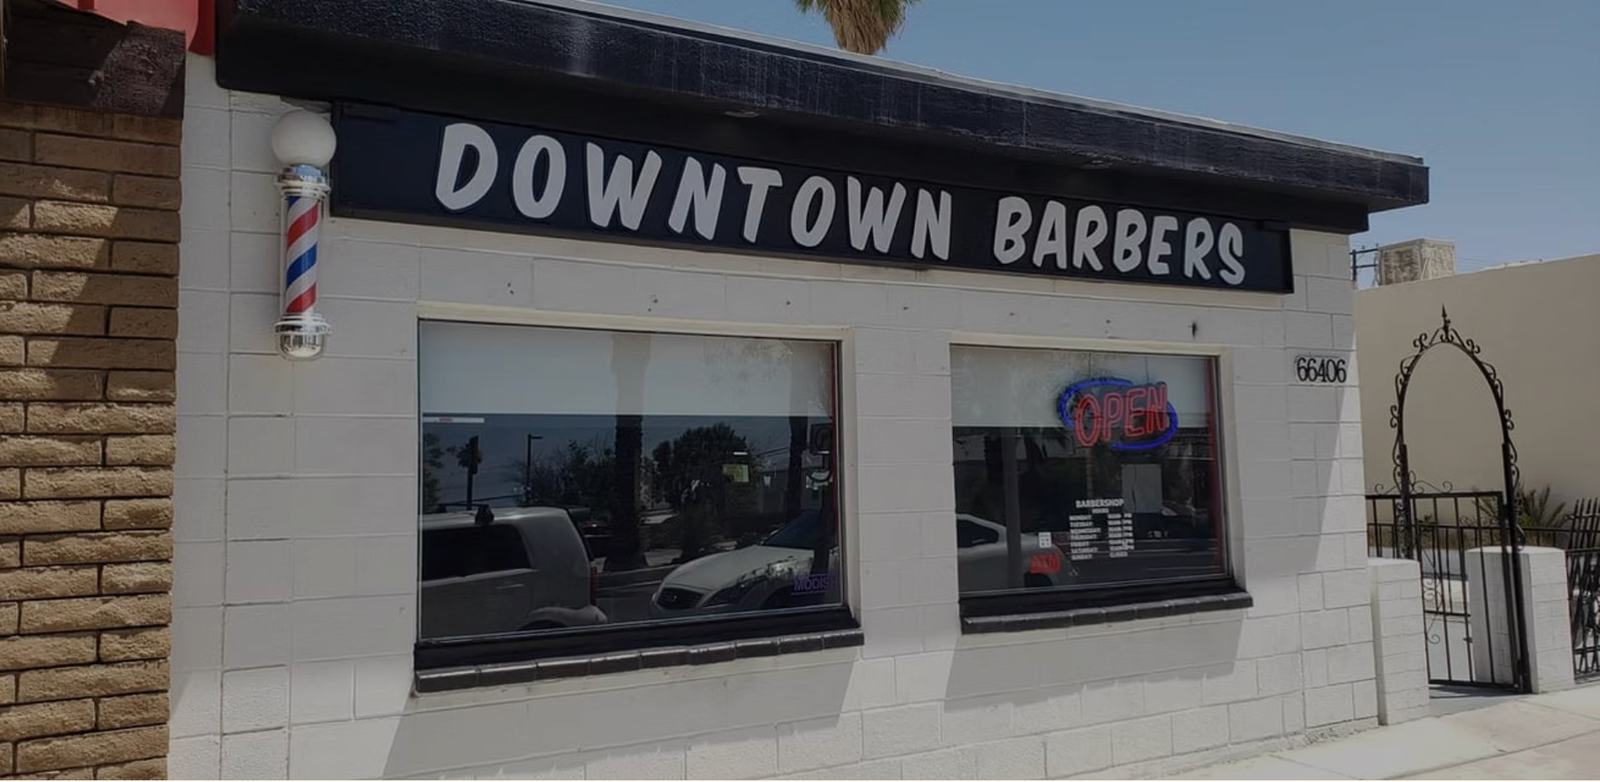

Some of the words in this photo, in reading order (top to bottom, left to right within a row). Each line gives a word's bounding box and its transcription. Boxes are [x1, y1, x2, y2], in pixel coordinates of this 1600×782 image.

[435, 122, 952, 261] DOWNTOWN
[993, 195, 1246, 285] BARBERS
[1296, 356, 1347, 383] 66406
[1075, 383, 1168, 447] OPEN
[1075, 498, 1124, 508] BARBERSHOP
